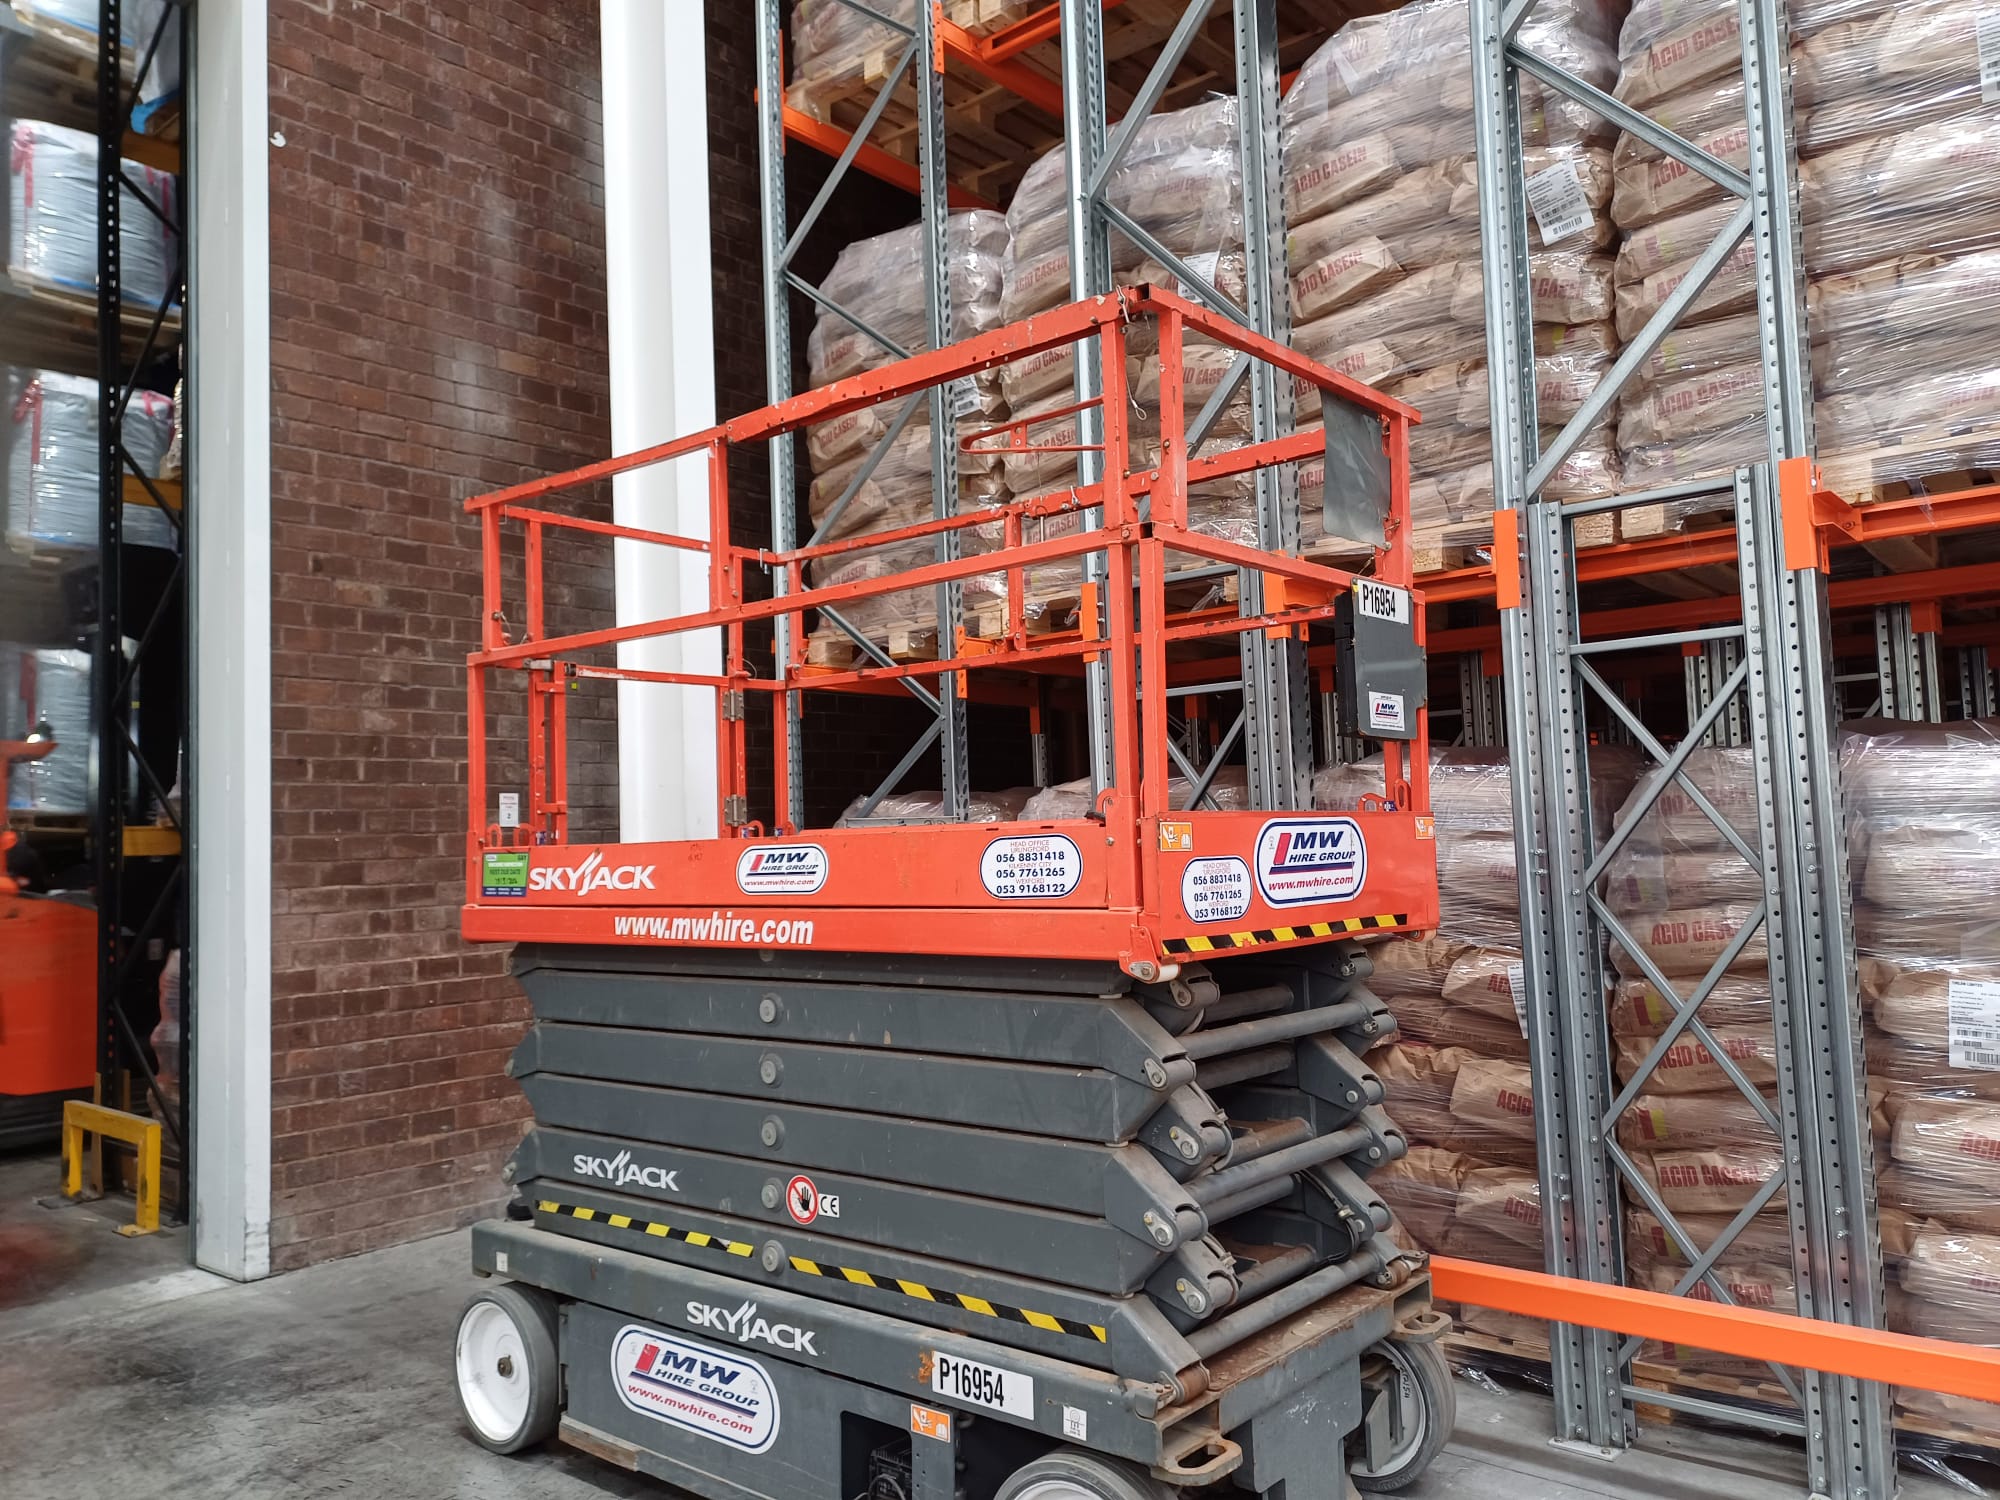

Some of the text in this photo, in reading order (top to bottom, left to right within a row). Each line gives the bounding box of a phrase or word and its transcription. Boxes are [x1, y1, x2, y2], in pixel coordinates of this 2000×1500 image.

[1651, 39, 1689, 71] ACID
[1294, 145, 1367, 193] ACID CASEIN
[1034, 255, 1068, 282] CASEIN
[1656, 390, 1694, 420] ACID
[1362, 583, 1396, 617] P16954
[1381, 703, 1396, 711] MW
[1292, 831, 1345, 850] MW
[764, 852, 809, 864] MW
[785, 863, 820, 871] GROUP
[996, 851, 1065, 863] 056 8831418
[1288, 850, 1356, 863] HIRE GROUP
[529, 849, 656, 896] SKYJACK
[744, 878, 814, 886] www.mwhire.com
[996, 867, 1065, 878] 056 7761265
[1193, 874, 1242, 885] 056 8831418
[1268, 875, 1354, 891] www.mwhire.com
[996, 883, 1065, 894] 053 9168122
[1194, 889, 1242, 902] 056 7761265
[1195, 905, 1242, 919] 053 9168122
[614, 911, 813, 945] www.mwhire.com
[1652, 922, 1689, 946] ACID
[1496, 1089, 1533, 1116] ACID
[573, 1149, 680, 1192] SKYJACK
[1660, 1164, 1699, 1188] ACID
[686, 1299, 818, 1357] SKYJACK
[661, 1350, 741, 1386] MW
[654, 1367, 761, 1408] HIRE GROUP
[939, 1356, 1004, 1408] P16954
[628, 1384, 753, 1435] www.mwhire.com
